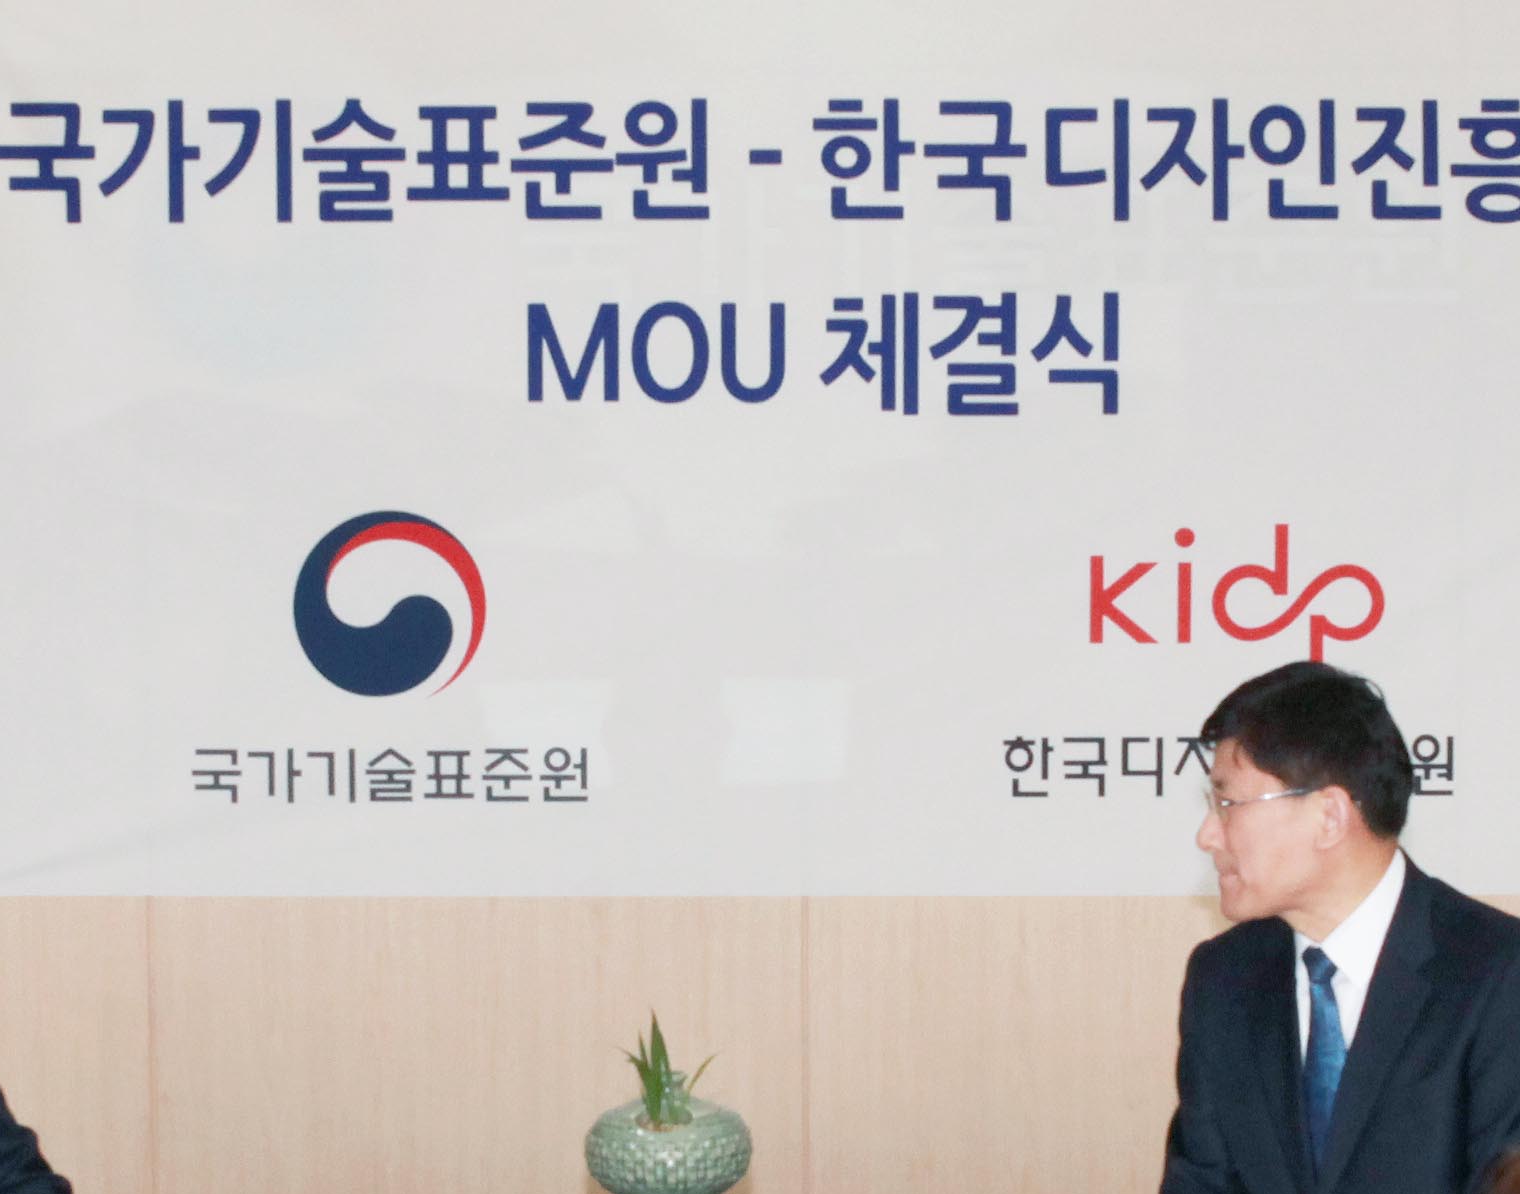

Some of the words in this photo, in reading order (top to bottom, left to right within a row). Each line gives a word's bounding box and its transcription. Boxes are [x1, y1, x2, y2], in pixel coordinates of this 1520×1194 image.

[526, 300, 787, 405] MOU
[818, 290, 1121, 418] 체결식
[191, 746, 589, 804] 국가기술표준원
